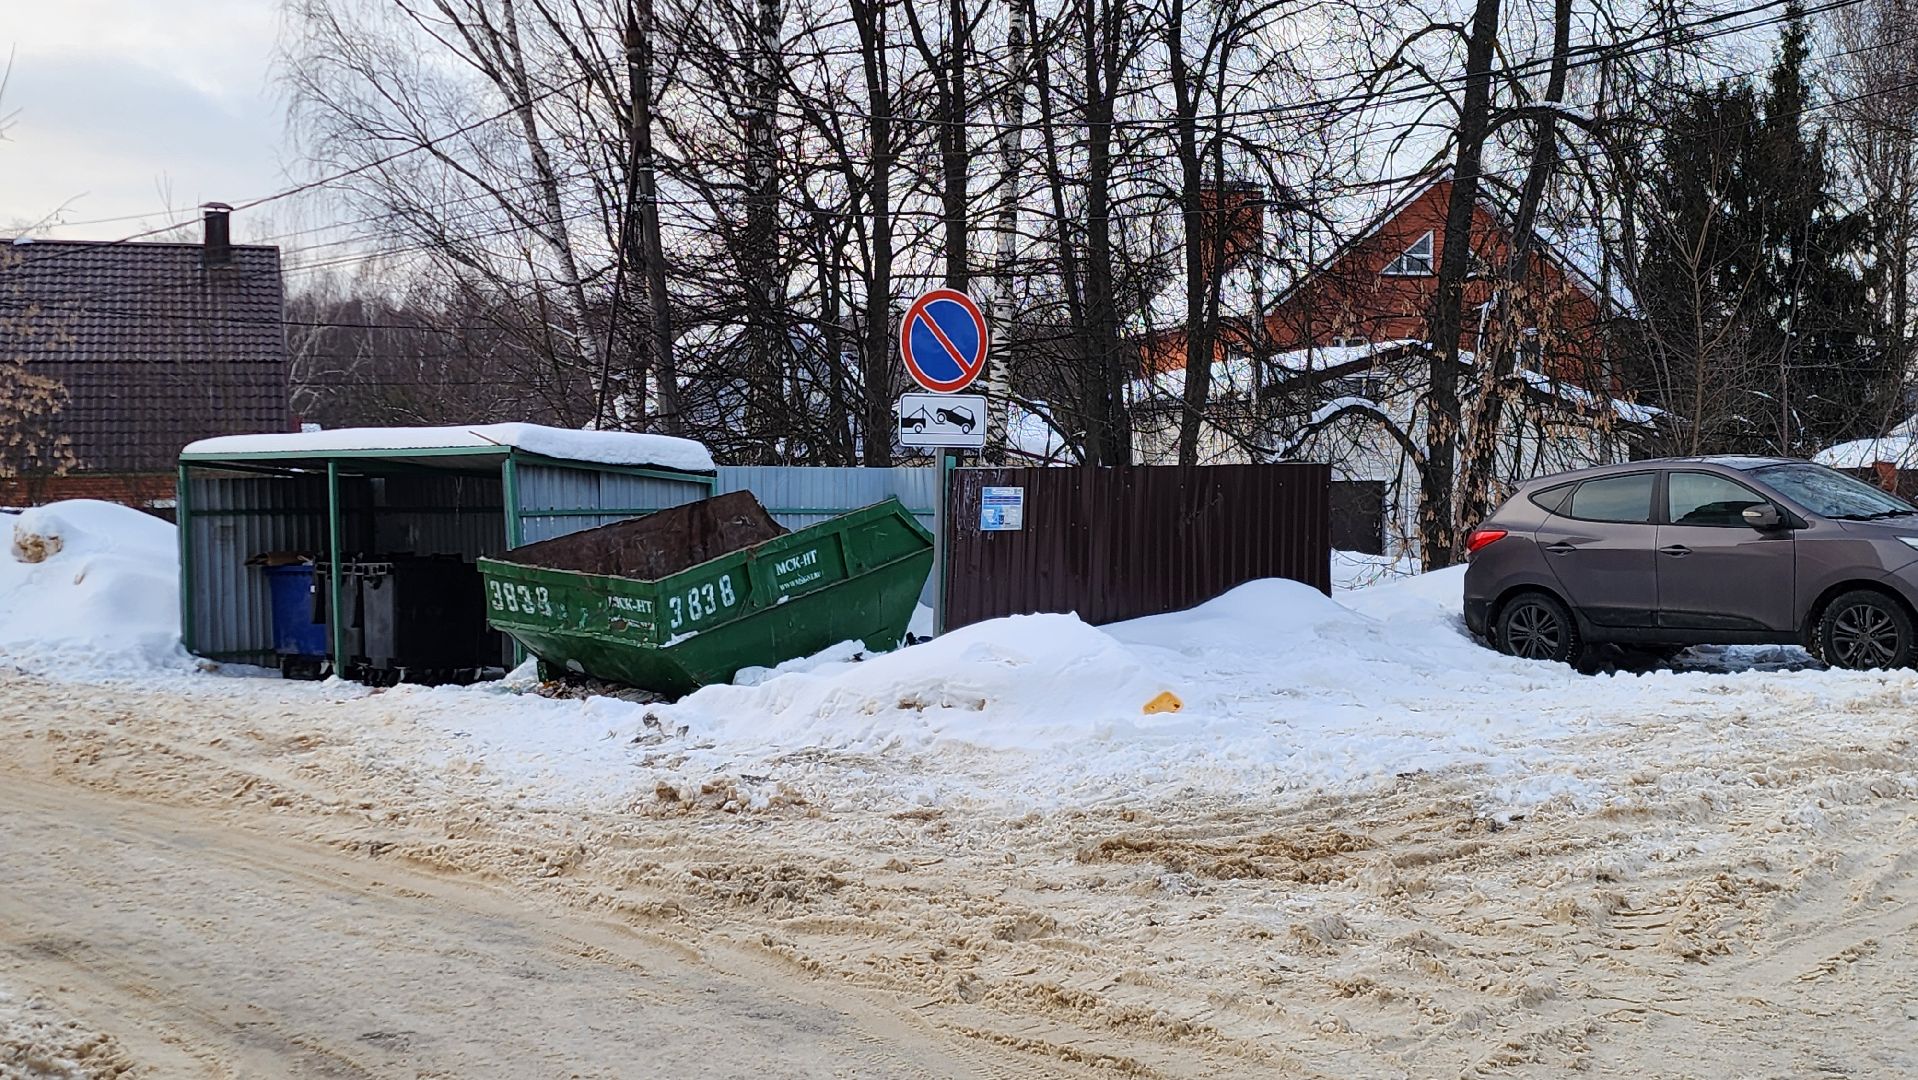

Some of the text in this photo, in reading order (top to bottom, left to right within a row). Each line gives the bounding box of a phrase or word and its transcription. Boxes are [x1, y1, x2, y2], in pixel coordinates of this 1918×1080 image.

[774, 549, 817, 576] МСК-НТ
[490, 579, 553, 616] 3838
[669, 574, 736, 628] 3838
